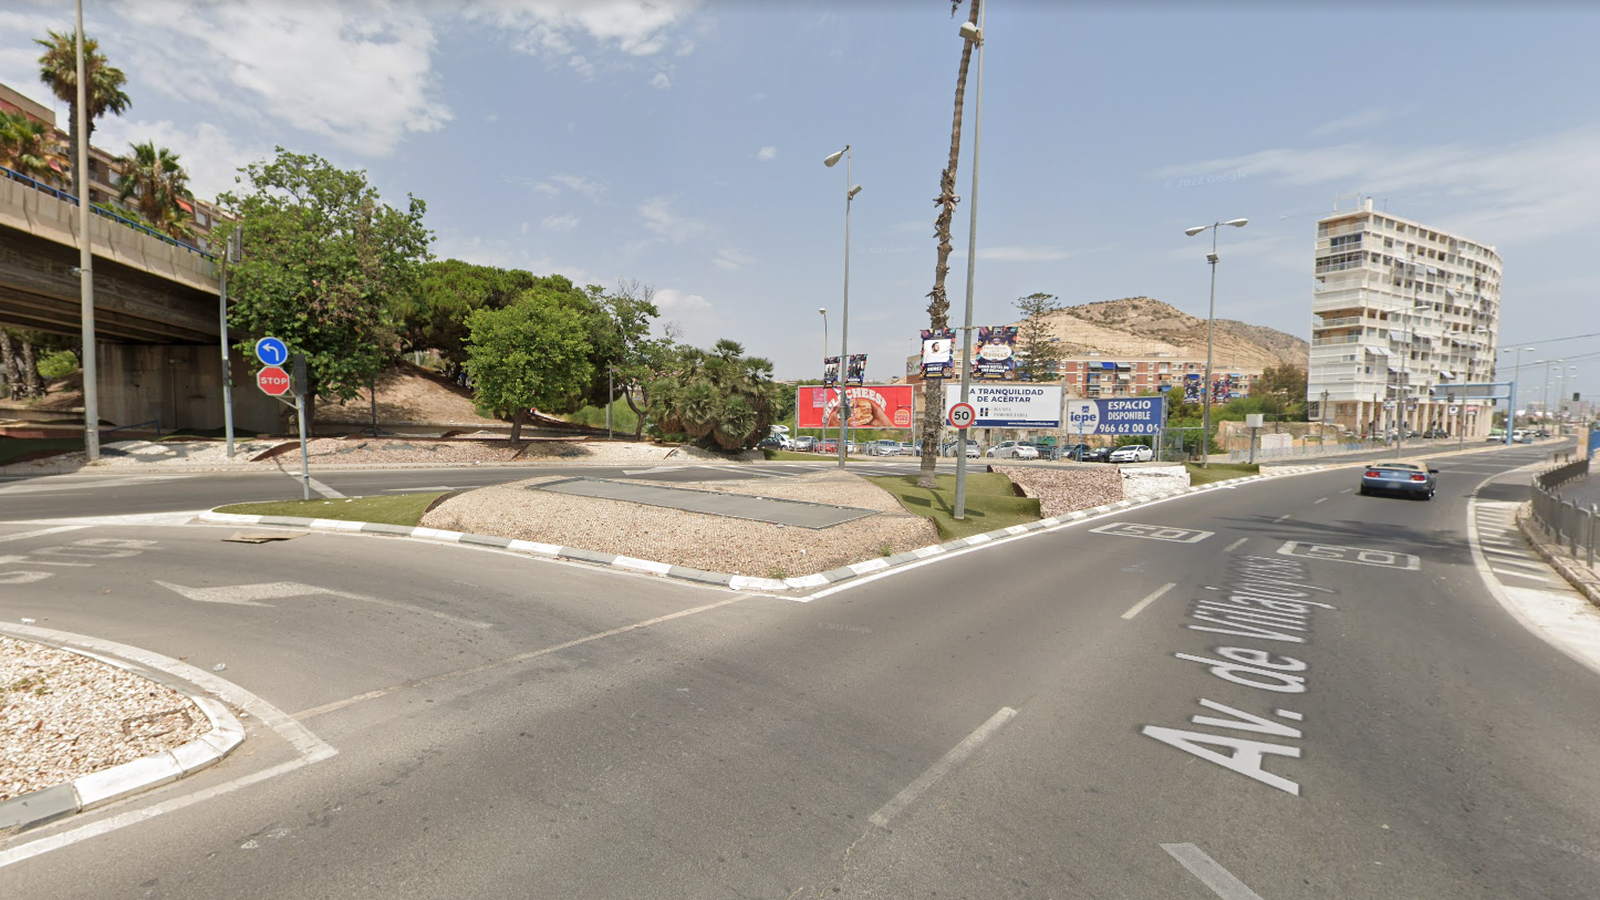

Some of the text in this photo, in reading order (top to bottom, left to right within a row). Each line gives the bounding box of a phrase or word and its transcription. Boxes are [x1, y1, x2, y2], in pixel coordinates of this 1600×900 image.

[261, 377, 287, 385] STOP
[978, 388, 1044, 396] TRANQUILIDAD
[845, 387, 887, 411] CHEESE
[976, 395, 989, 403] DE
[1108, 400, 1151, 410] ESPACIO
[954, 411, 970, 420] 50
[1070, 412, 1097, 423] iepe
[1108, 411, 1151, 420] DISPONIBLE
[1099, 424, 1116, 433] 966
[1118, 424, 1129, 433] 62
[1132, 424, 1144, 433] 00
[1112, 525, 1190, 538] 50
[1306, 545, 1395, 564] 50
